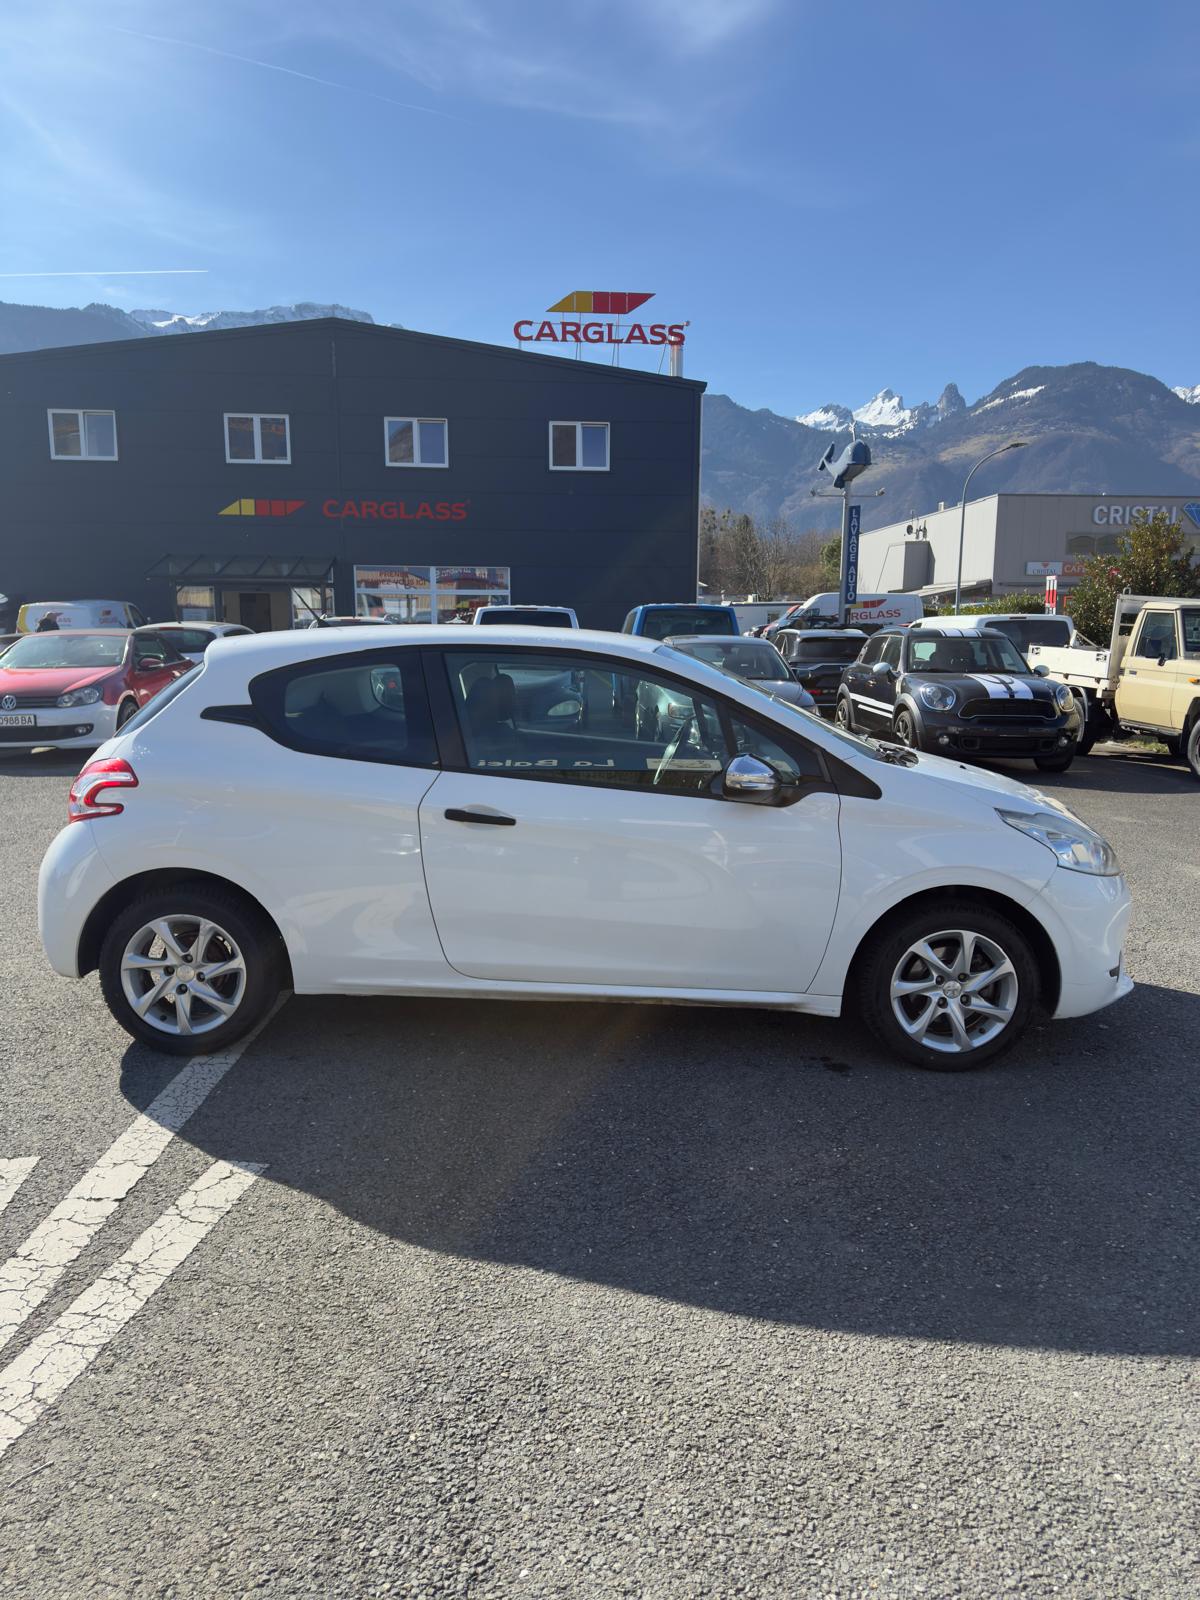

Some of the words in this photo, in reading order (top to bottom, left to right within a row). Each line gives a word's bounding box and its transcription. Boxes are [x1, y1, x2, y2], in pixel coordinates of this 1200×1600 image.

[513, 319, 686, 345] CARGLASS
[322, 499, 468, 521] CARGLASS
[849, 508, 859, 562] LAVAGE
[847, 566, 857, 600] AUTO
[850, 608, 902, 621] RGLASS
